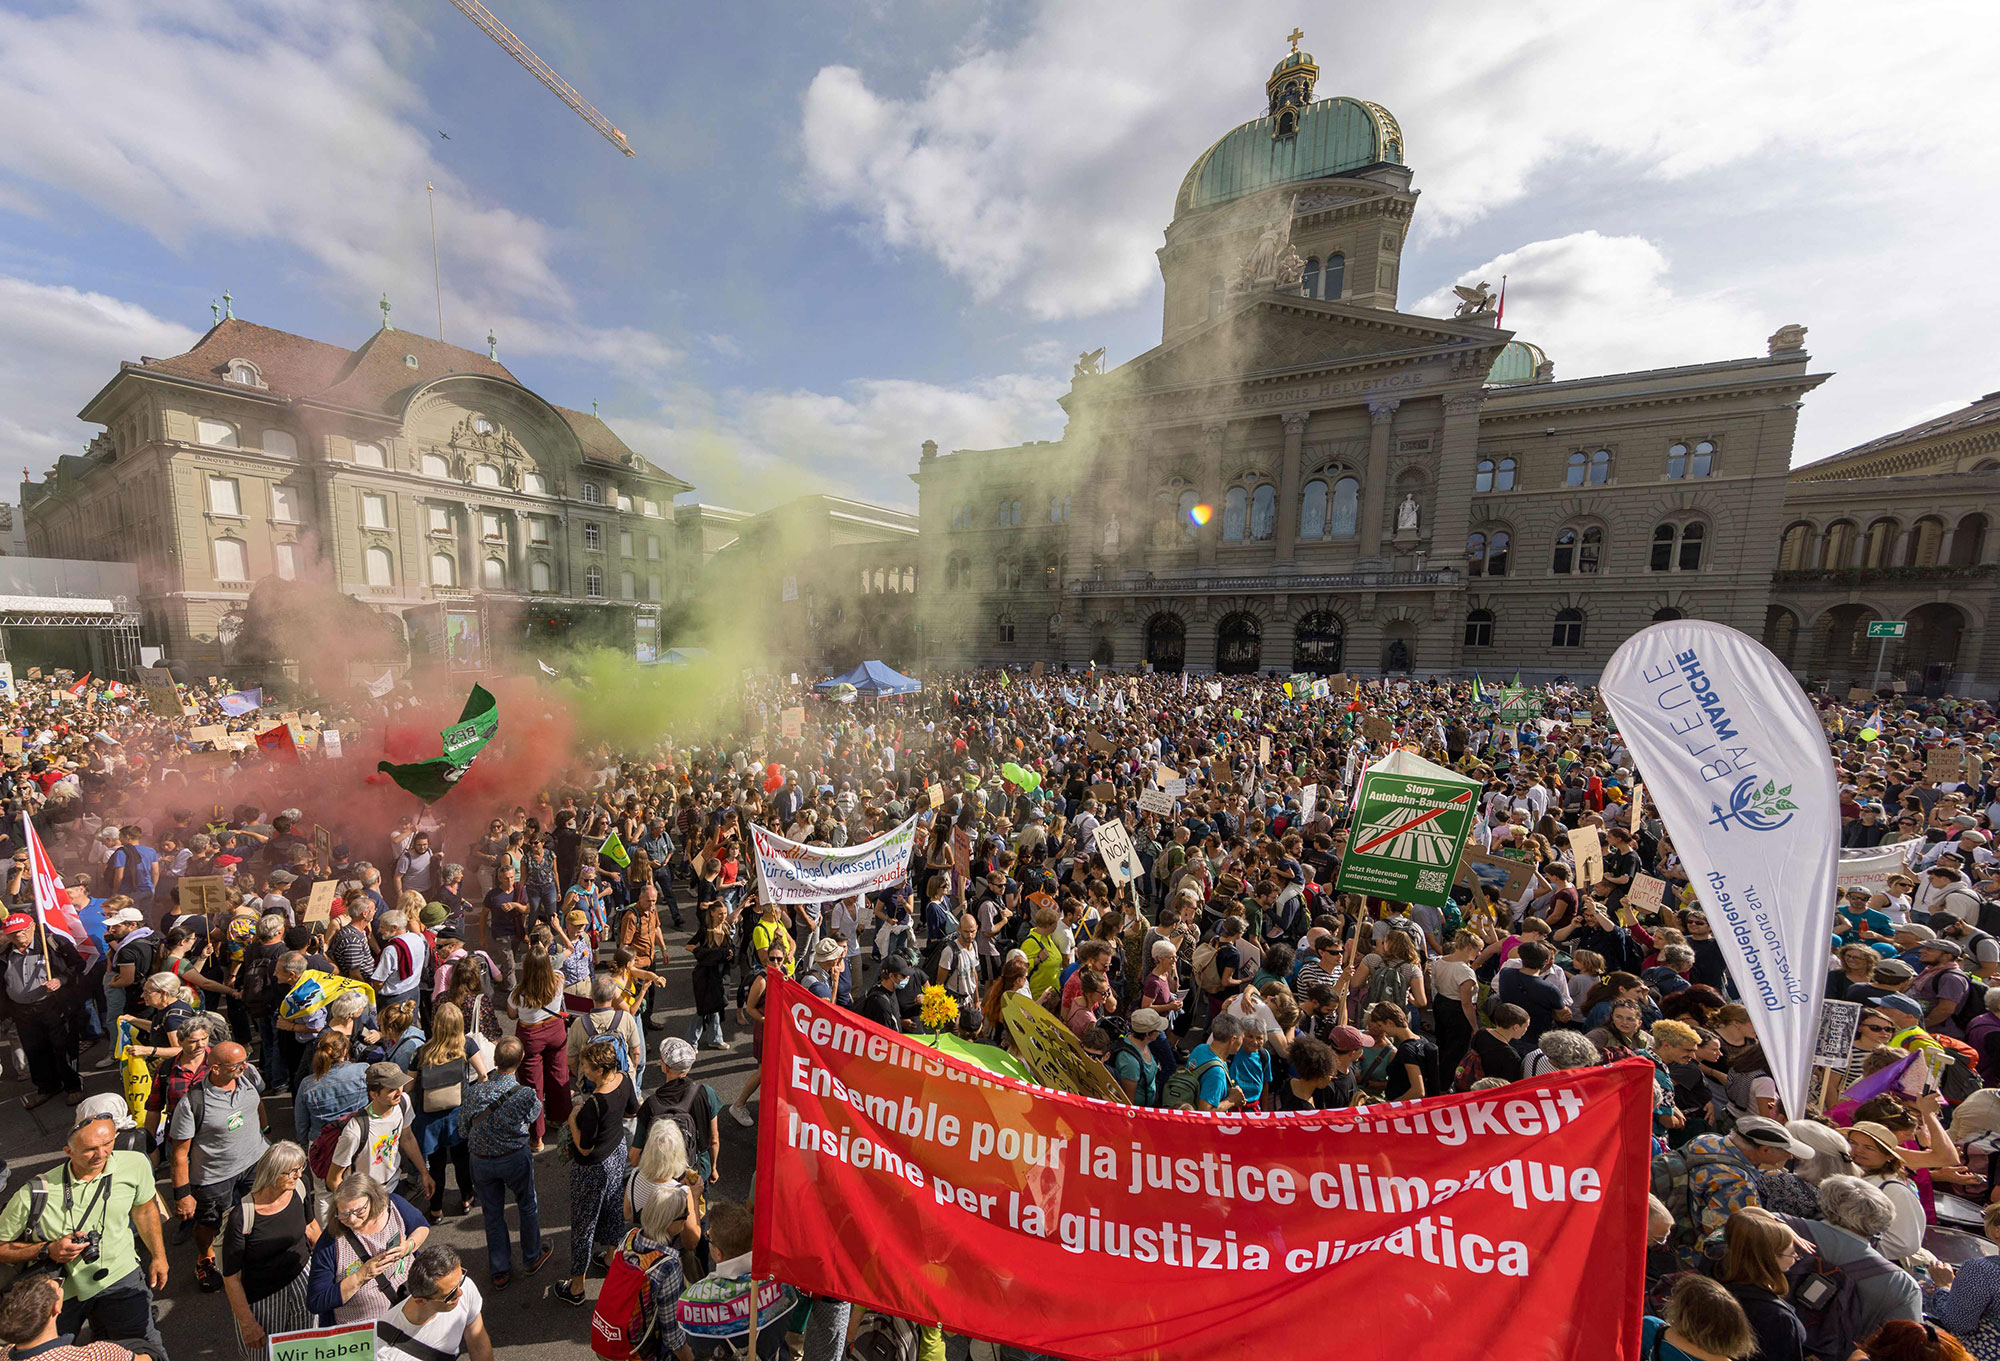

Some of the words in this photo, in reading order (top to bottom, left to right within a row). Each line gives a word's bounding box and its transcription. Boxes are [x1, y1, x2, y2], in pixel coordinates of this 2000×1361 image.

[1166, 388, 1309, 415] CONOEDERATIONIS
[1319, 373, 1423, 396] HELVETICAE
[1405, 783, 1436, 797] Stopp
[1369, 791, 1467, 813] Autobahn-Bauwahn
[1097, 823, 1120, 847] ACT
[1105, 838, 1130, 861] NOW
[1345, 872, 1398, 886] unterschreiben
[1347, 864, 1365, 873] Jetzt
[1366, 867, 1409, 880] Referendum
[1634, 876, 1665, 895] CLIMATE
[791, 1054, 961, 1147] Ensemble
[970, 1121, 1068, 1170] pour
[1079, 1133, 1118, 1181] la
[1128, 1141, 1296, 1206] justice
[1309, 1159, 1602, 1214] climatique
[788, 1112, 925, 1188] Insieme
[932, 1175, 998, 1220] per
[1008, 1190, 1047, 1239] la
[1059, 1208, 1270, 1271] giustizia
[1285, 1215, 1530, 1278] climatica
[683, 1305, 731, 1324] DEINE
[277, 1349, 309, 1361] Wir
[315, 1341, 371, 1360] haben
